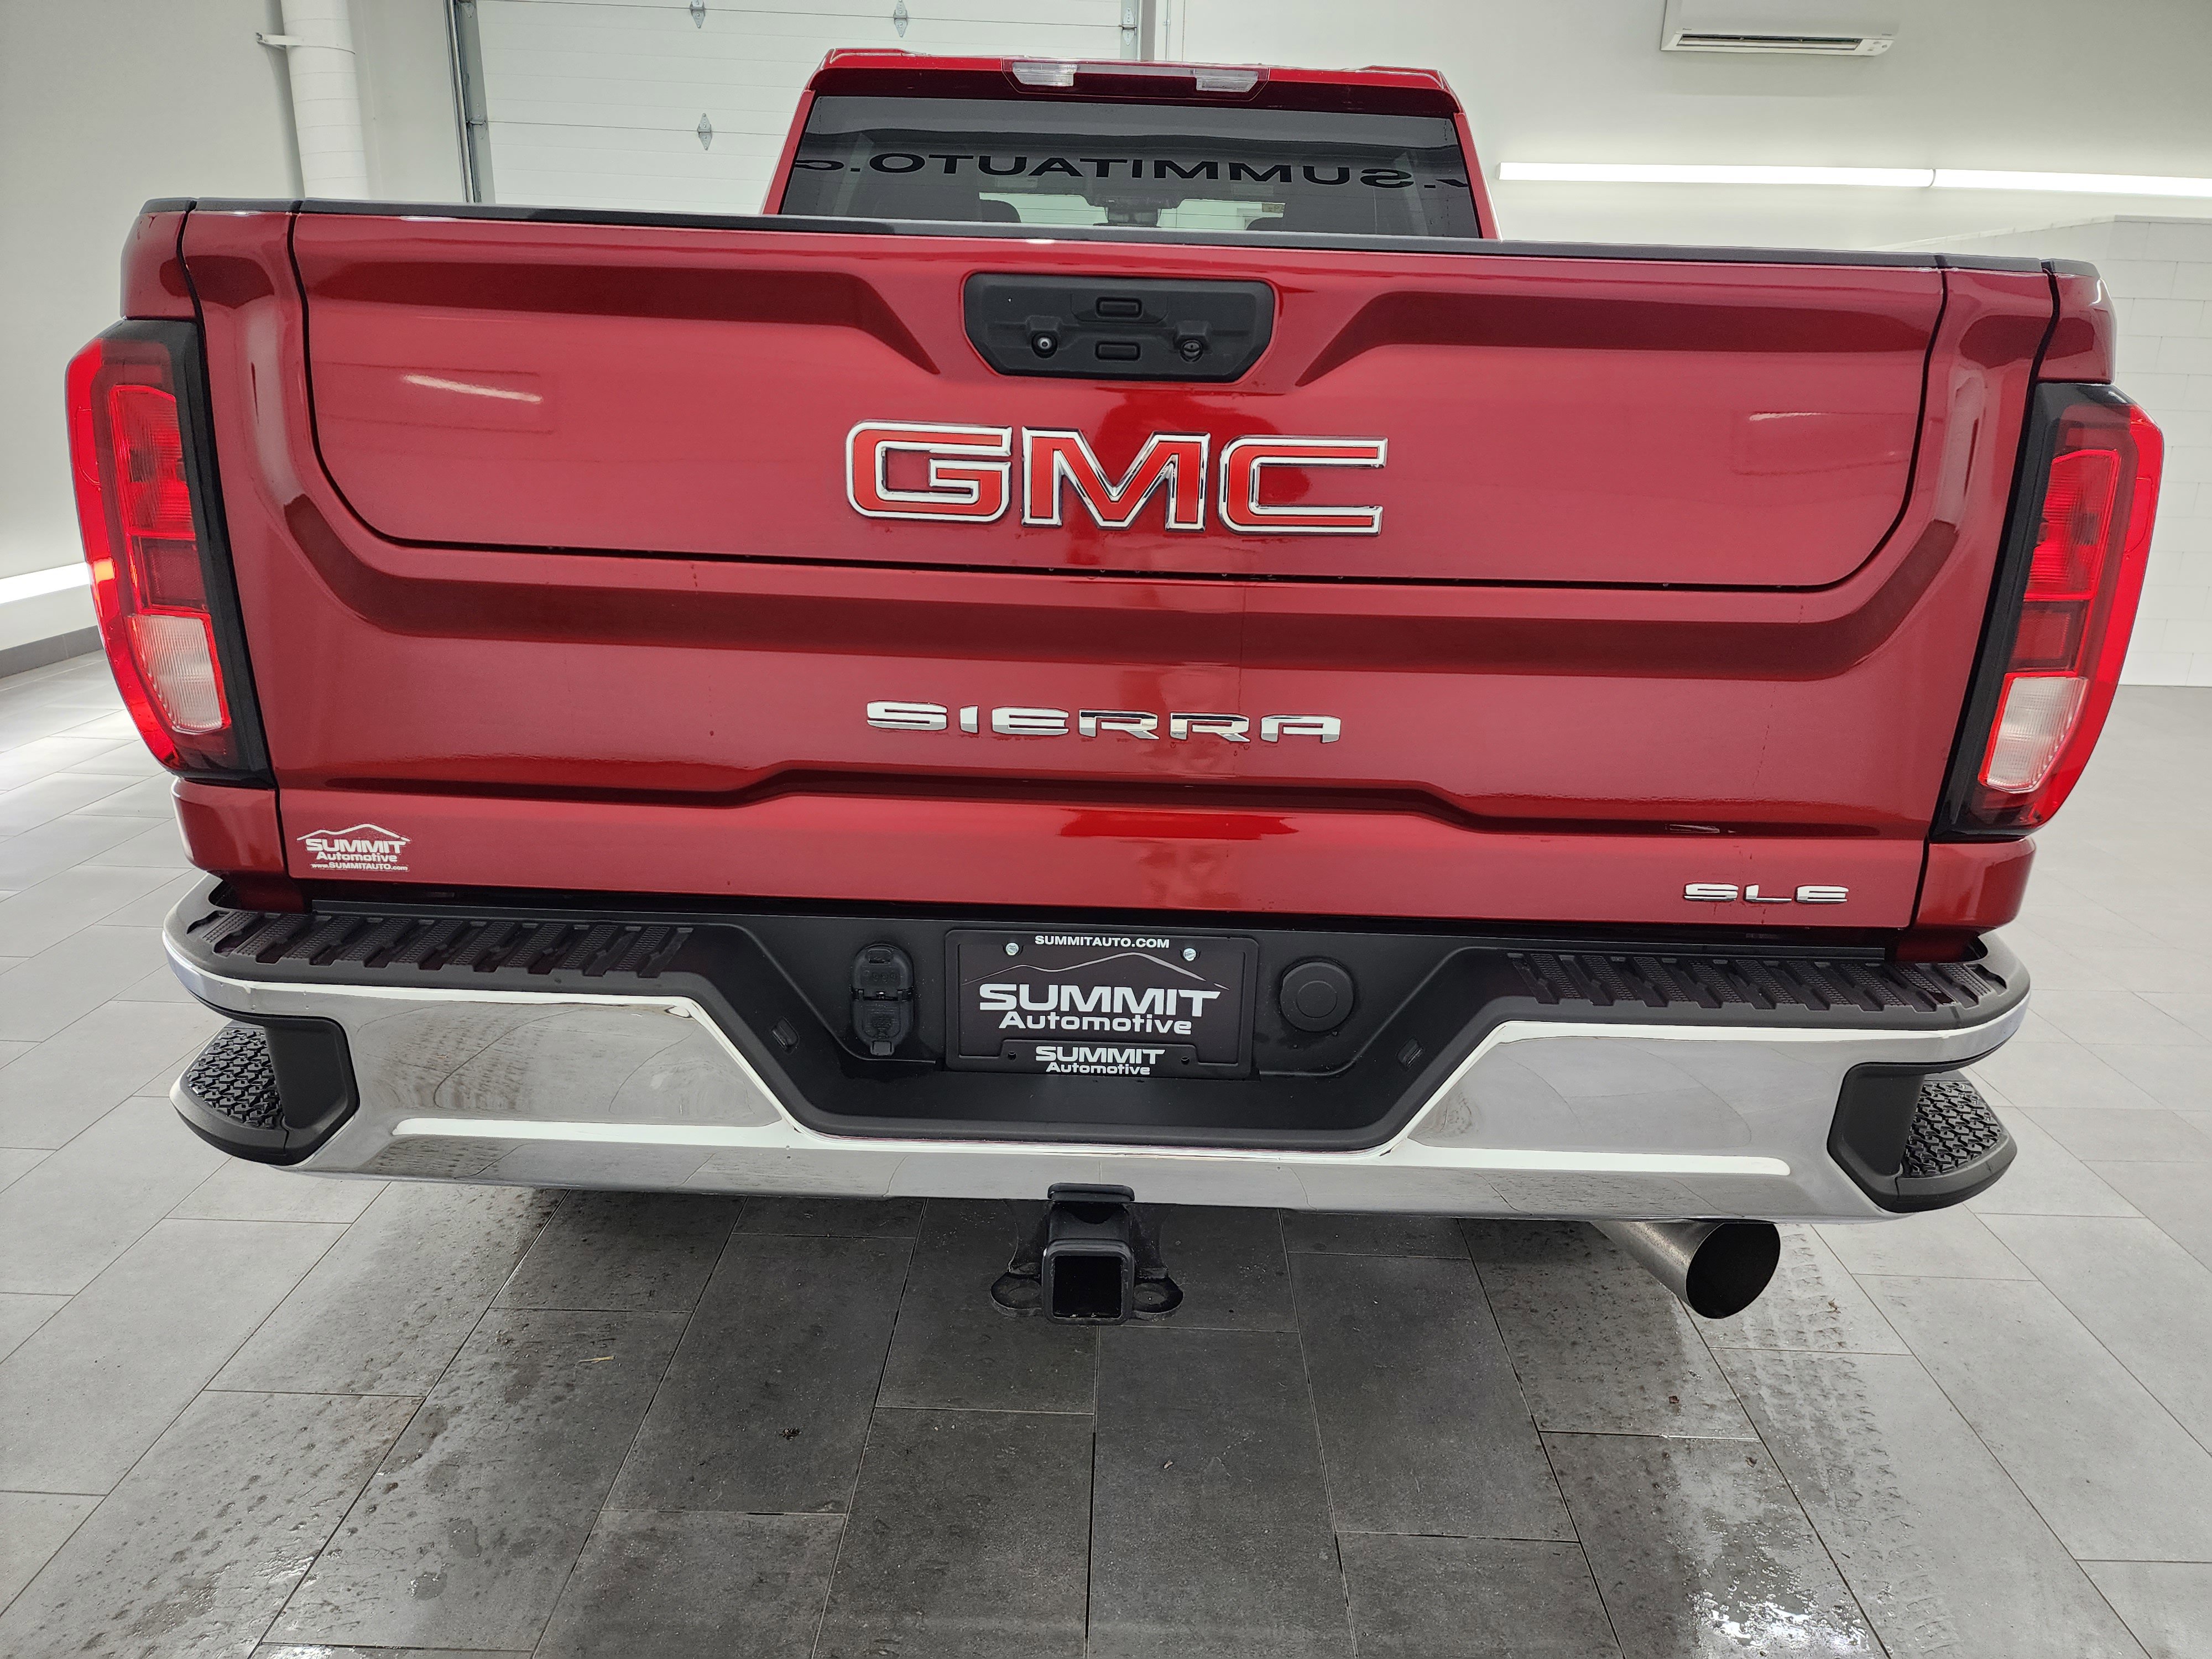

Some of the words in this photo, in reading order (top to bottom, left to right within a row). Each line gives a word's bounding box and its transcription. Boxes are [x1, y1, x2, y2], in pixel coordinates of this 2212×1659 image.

[844, 419, 1390, 536] GMC
[867, 700, 1341, 744] SIERRA
[305, 838, 406, 854] SUMMIT
[316, 851, 398, 862] Automotive
[311, 862, 409, 871] www.SUMMITAUTO.com
[1684, 883, 1849, 904] SLE
[1035, 935, 1170, 948] SUMMITAUTO.COM
[979, 983, 1221, 1018] SUMMIT
[998, 1011, 1192, 1035] Automotive
[1035, 1046, 1166, 1065] SUMMIT
[1045, 1062, 1151, 1075] Automotive
